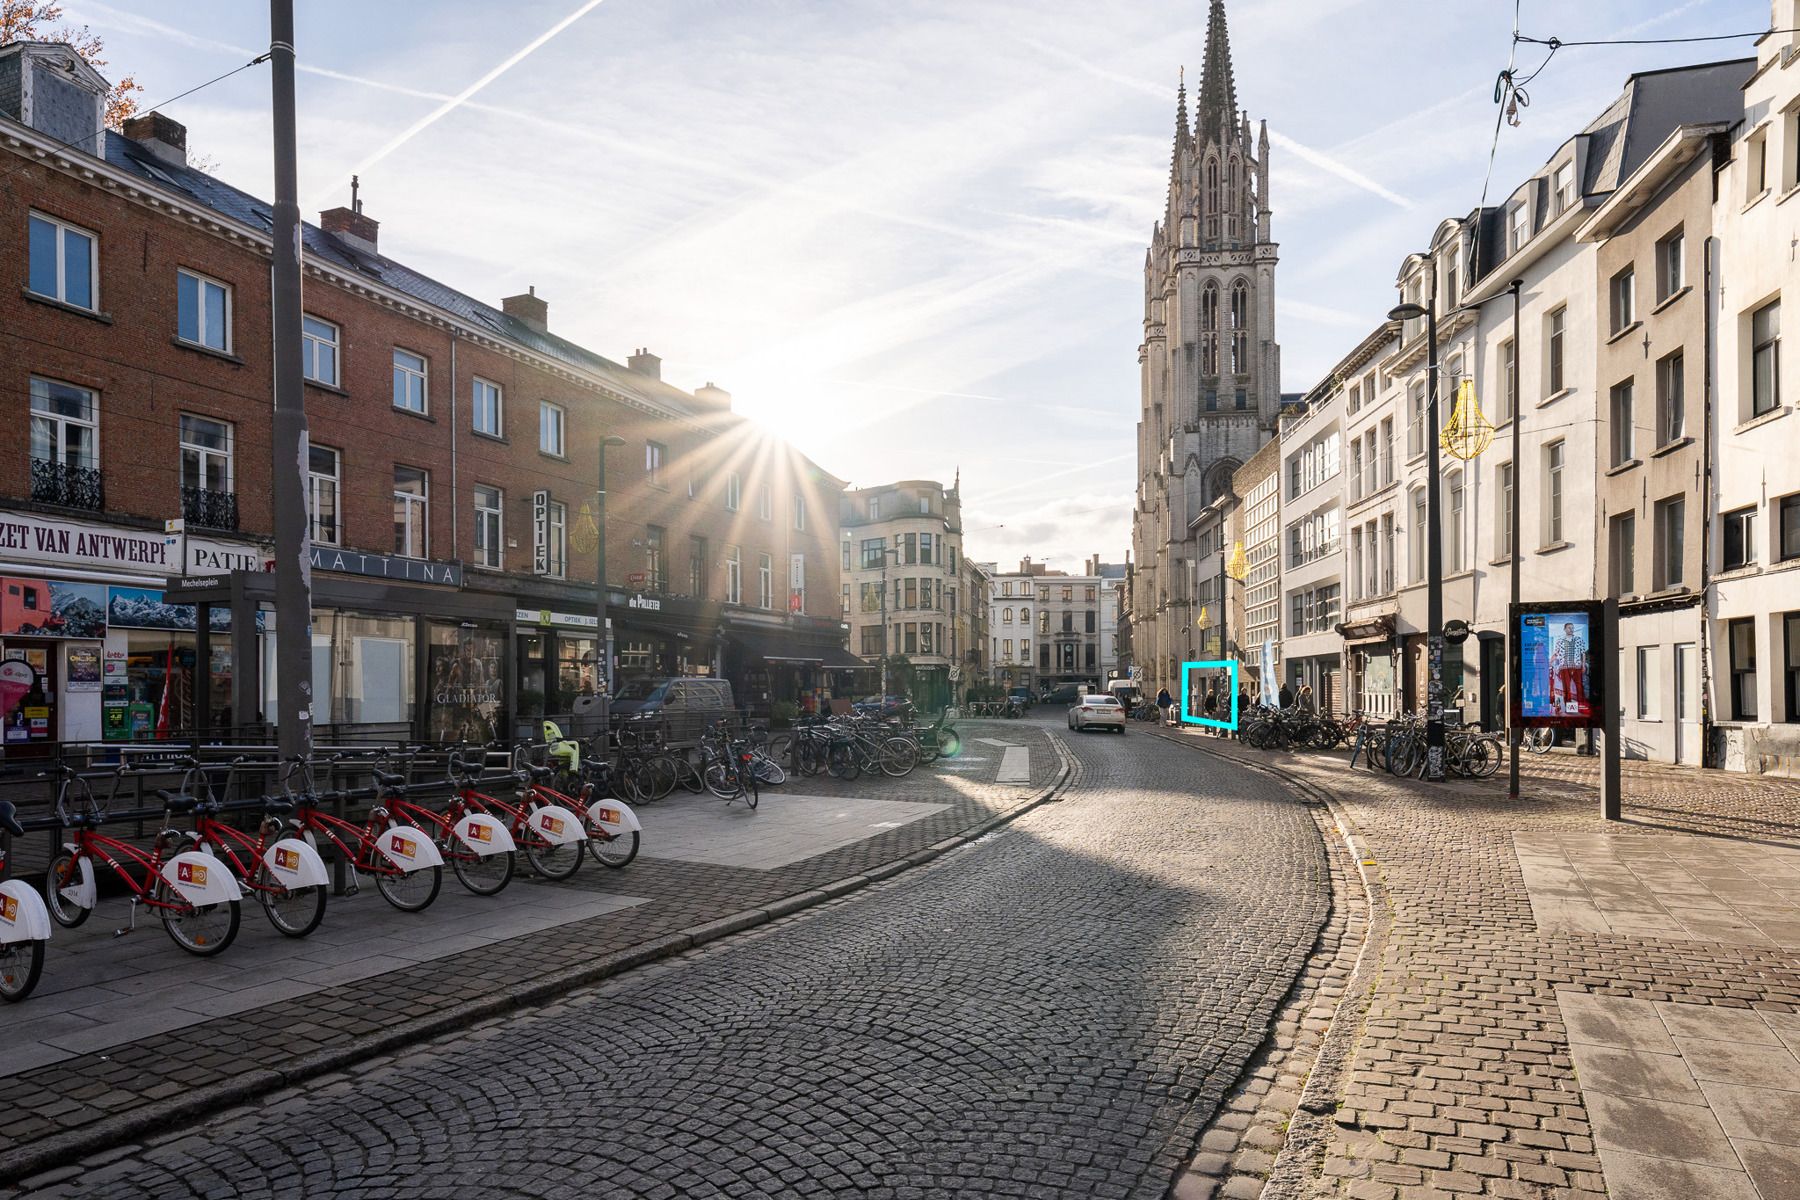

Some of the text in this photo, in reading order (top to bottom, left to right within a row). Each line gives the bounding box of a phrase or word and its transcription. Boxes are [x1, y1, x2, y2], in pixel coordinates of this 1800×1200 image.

[535, 493, 545, 571] OPTIEK
[34, 526, 71, 554] VAN
[309, 549, 454, 583] MATTINA
[181, 577, 219, 588] Mechelseplein
[564, 615, 581, 624] OPTIEK
[437, 692, 497, 704] GLADIATOR
[181, 867, 190, 878] A
